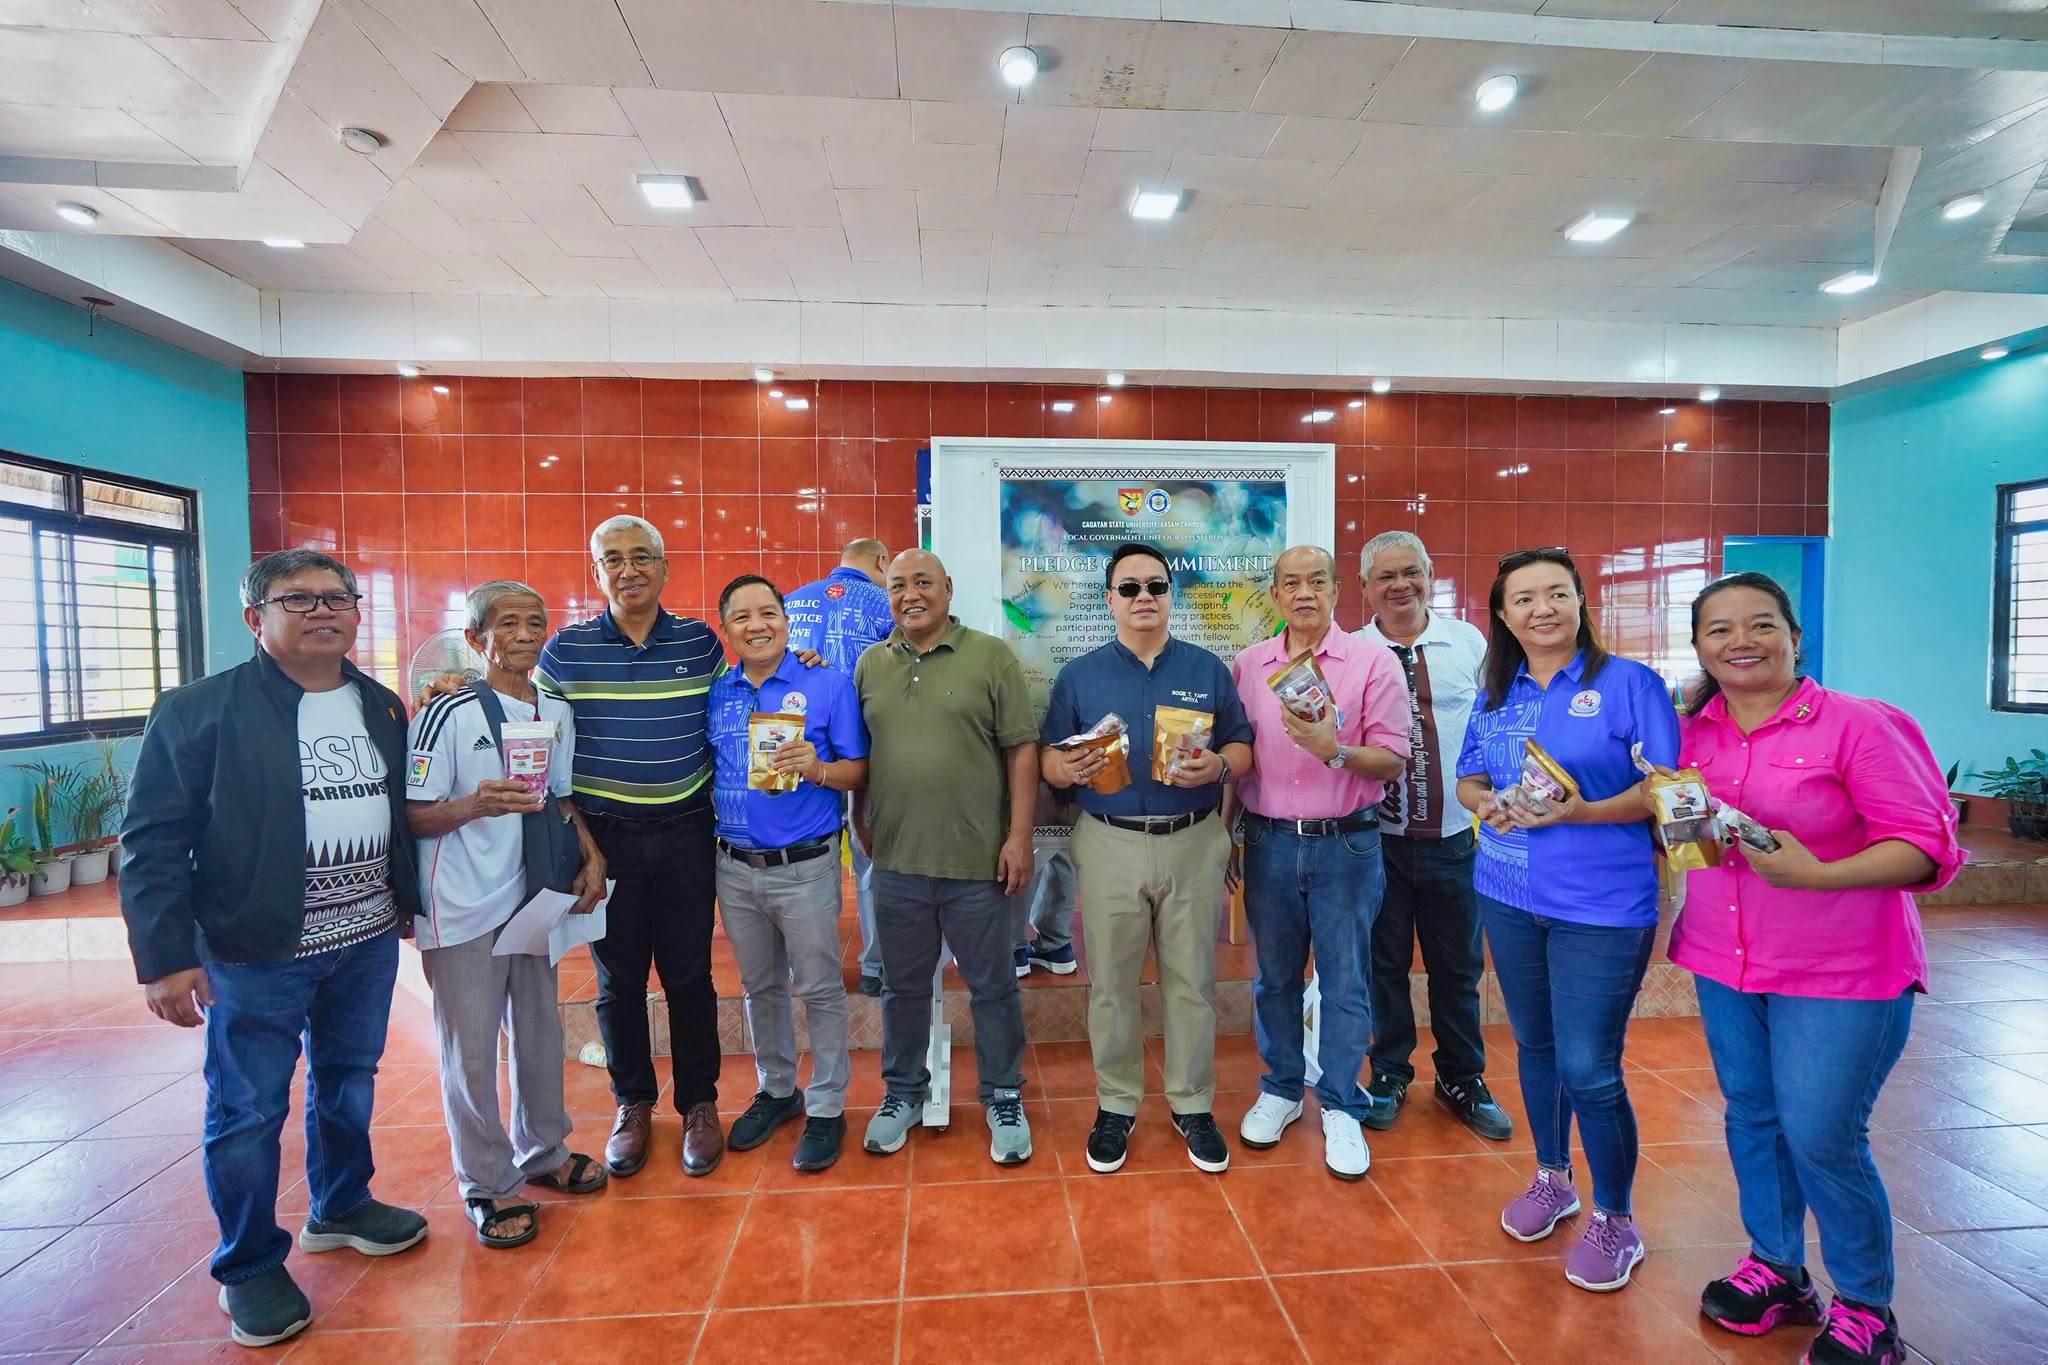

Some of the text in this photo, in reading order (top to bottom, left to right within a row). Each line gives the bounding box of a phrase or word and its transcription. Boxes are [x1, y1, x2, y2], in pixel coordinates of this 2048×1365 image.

[1019, 556, 1098, 572] PLEDGE
[1165, 556, 1272, 572] MMITMENT
[1053, 582, 1069, 590] We
[1071, 581, 1105, 592] hereby
[1216, 581, 1227, 589] to
[1228, 580, 1244, 589] the
[1069, 592, 1099, 600] Cacao
[785, 599, 820, 609] UBLIC
[1174, 602, 1183, 610] to
[1185, 602, 1228, 612] adopting
[1190, 612, 1234, 623] practices,
[1055, 623, 1242, 633] participating and workshops,
[1067, 634, 1085, 642] and
[1180, 633, 1201, 641] with
[1203, 632, 1231, 641] fellow
[1231, 643, 1247, 651] the
[303, 780, 387, 801] ARROWS
[1411, 781, 1428, 798] and
[1412, 798, 1428, 822] Cacao
